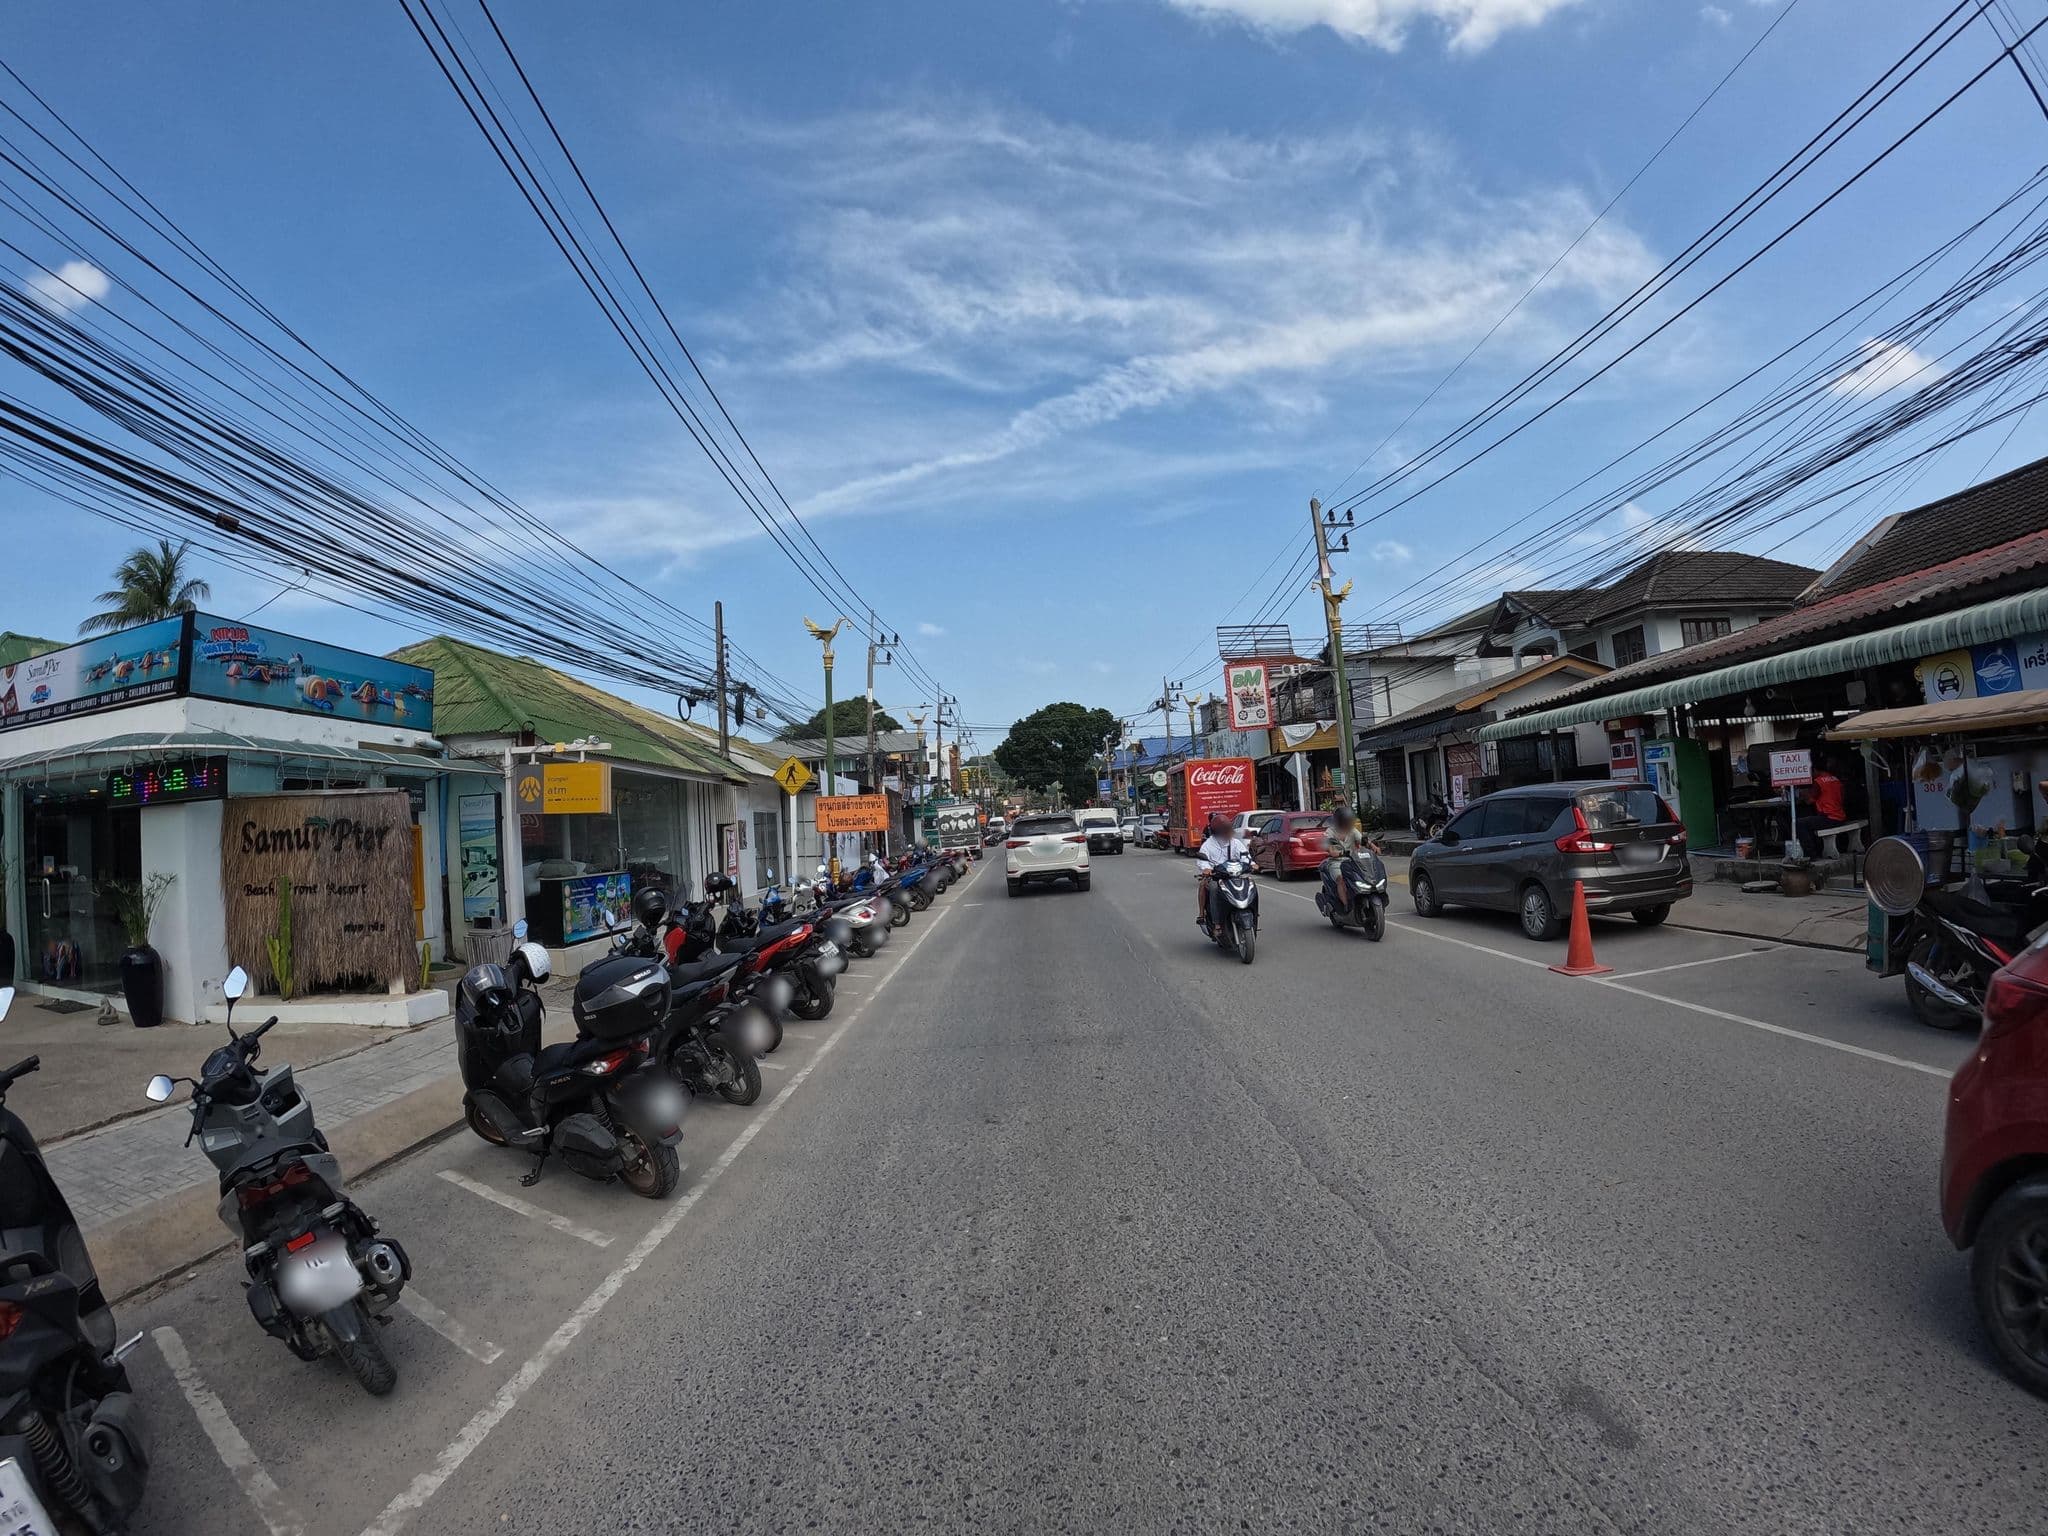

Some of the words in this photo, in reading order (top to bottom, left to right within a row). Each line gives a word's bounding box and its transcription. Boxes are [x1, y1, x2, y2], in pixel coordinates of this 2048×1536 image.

[1232, 669, 1262, 688] BM
[112, 691, 125, 701] TRIPS
[128, 685, 151, 698] CHILDREN
[151, 680, 175, 691] FRIENDLY
[1780, 754, 1801, 764] TAXI
[1190, 765, 1246, 787] Coca-Cola
[1774, 765, 1809, 775] SERVICE
[547, 787, 567, 795] atm
[243, 881, 276, 897] Beach
[288, 882, 318, 895] ront
[326, 882, 368, 896] Resort
